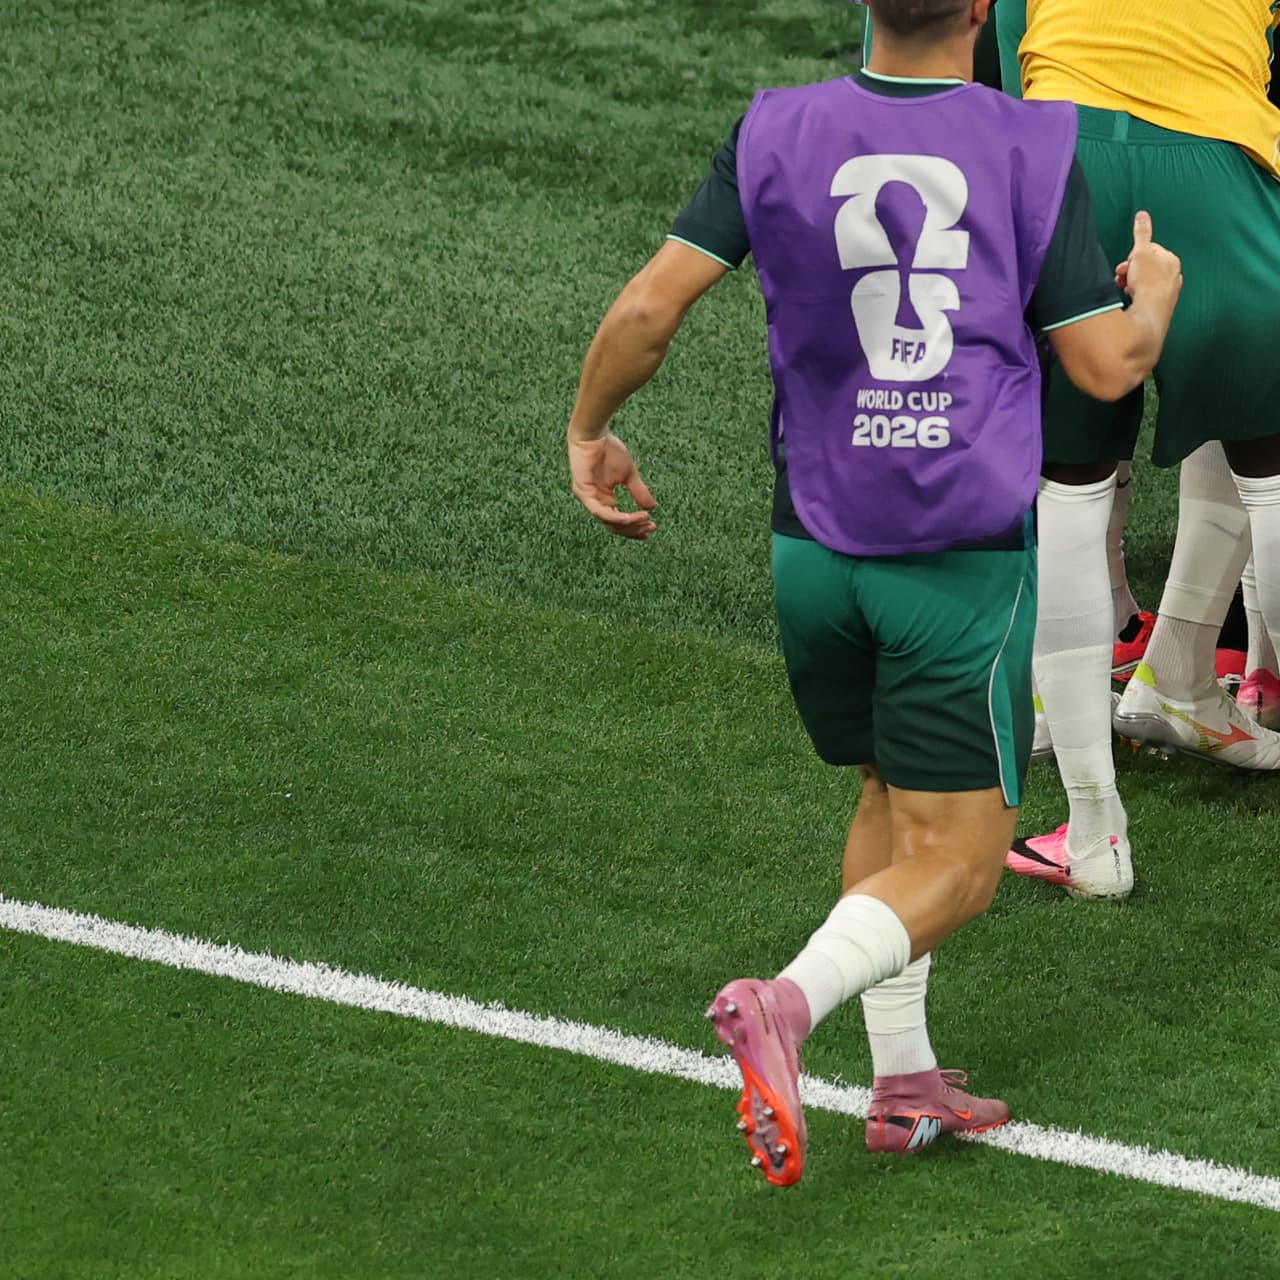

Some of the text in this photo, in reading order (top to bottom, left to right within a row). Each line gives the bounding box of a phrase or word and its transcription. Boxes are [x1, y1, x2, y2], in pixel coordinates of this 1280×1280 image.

[891, 338, 927, 363] FIFA
[857, 389, 952, 412] WORLD CUP
[852, 414, 950, 449] 2026
